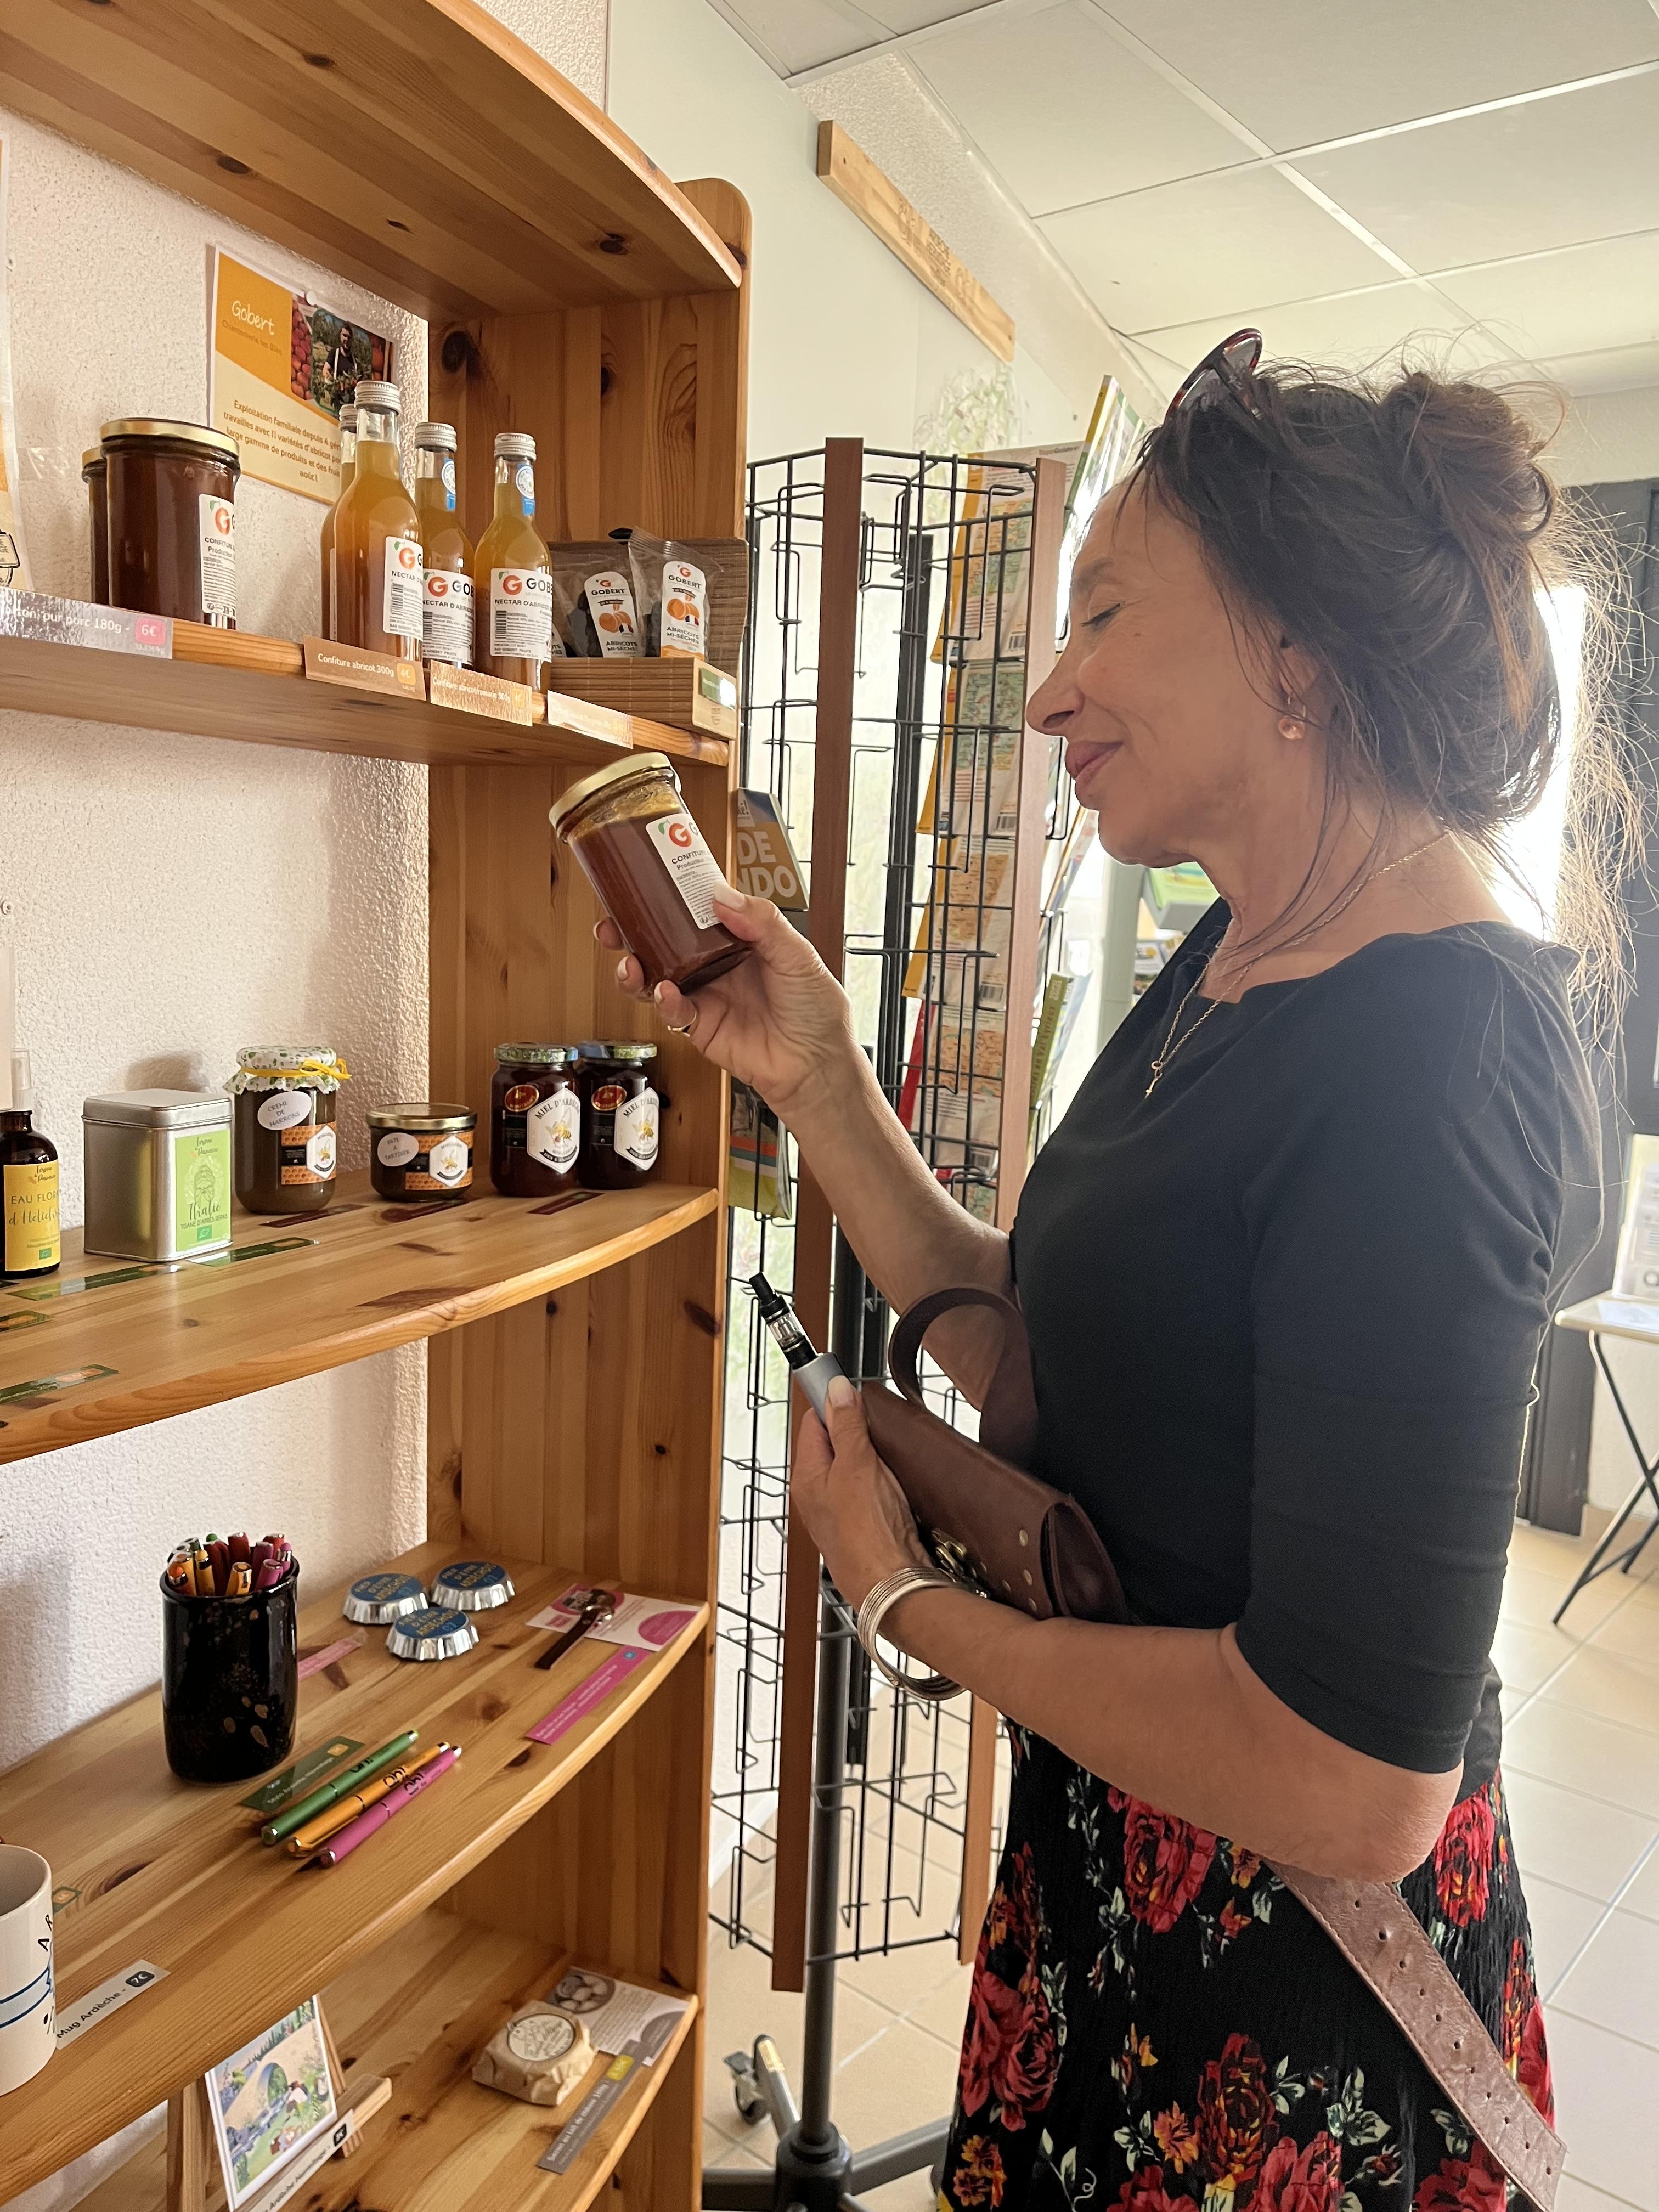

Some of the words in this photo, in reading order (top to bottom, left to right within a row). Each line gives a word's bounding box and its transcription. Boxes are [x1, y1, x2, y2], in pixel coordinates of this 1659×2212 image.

[232, 300, 274, 335] Gobert
[234, 399, 273, 424] Exploitation
[274, 417, 301, 435] familiale
[302, 429, 323, 445] depuis
[224, 411, 253, 430] travailles
[255, 425, 270, 437] avec
[278, 435, 303, 449] variétés
[304, 444, 330, 459] d'abricot
[227, 426, 243, 441] large
[245, 436, 269, 450] gamme
[271, 445, 279, 454] de
[281, 449, 307, 465] produits
[316, 462, 327, 472] des
[392, 571, 416, 581] NECTAR
[669, 575, 702, 589] GOBERT
[42, 611, 63, 623] pur
[66, 616, 91, 627] porc
[94, 618, 122, 633] 180g
[141, 624, 157, 637] 6€
[667, 627, 699, 640] ABRICOTS
[318, 653, 351, 668] Confiture
[352, 662, 375, 672] abricot
[376, 665, 394, 678] 300g
[432, 676, 457, 691] Confiture
[737, 831, 777, 865] DE
[269, 1111, 300, 1127] MARRONS
[535, 1103, 553, 1120] MIEL
[623, 1103, 640, 1118] MIEL
[11, 1195, 33, 1205] EAU
[189, 1198, 221, 1221] Thalie
[180, 1220, 196, 1229] TISANE
[197, 1216, 215, 1227] D'APRÈS
[215, 1214, 228, 1222] REPAS
[57, 2022, 81, 2039] Mug
[81, 1992, 121, 2021] Ardèche
[131, 1973, 148, 1984] 7€
